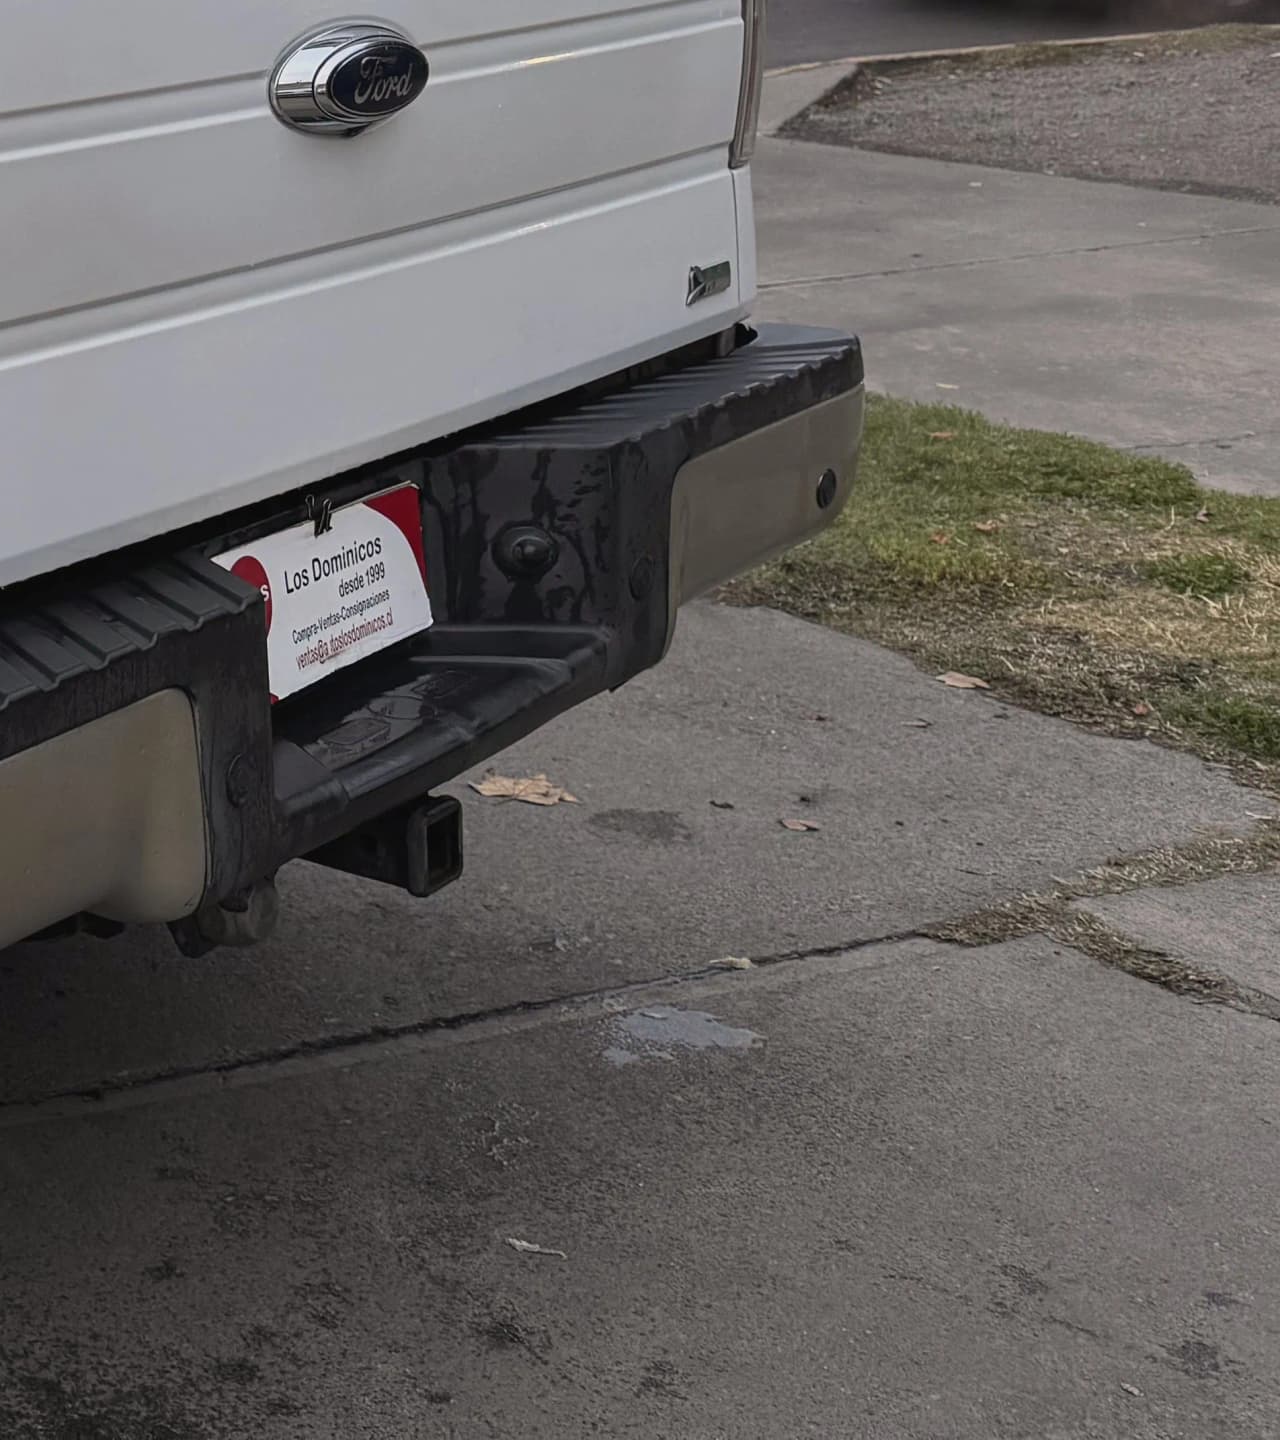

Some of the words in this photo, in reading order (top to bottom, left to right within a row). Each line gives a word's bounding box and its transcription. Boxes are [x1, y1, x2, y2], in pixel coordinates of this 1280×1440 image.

[354, 56, 413, 105] Ford
[284, 568, 309, 595] Los
[312, 537, 382, 582] Dominicos
[339, 571, 365, 598] desde
[365, 561, 386, 587] 1999
[292, 589, 390, 645] Compra-Ventas-Consignaciones
[296, 606, 394, 670] ventas@atoslosdominicos.cl
